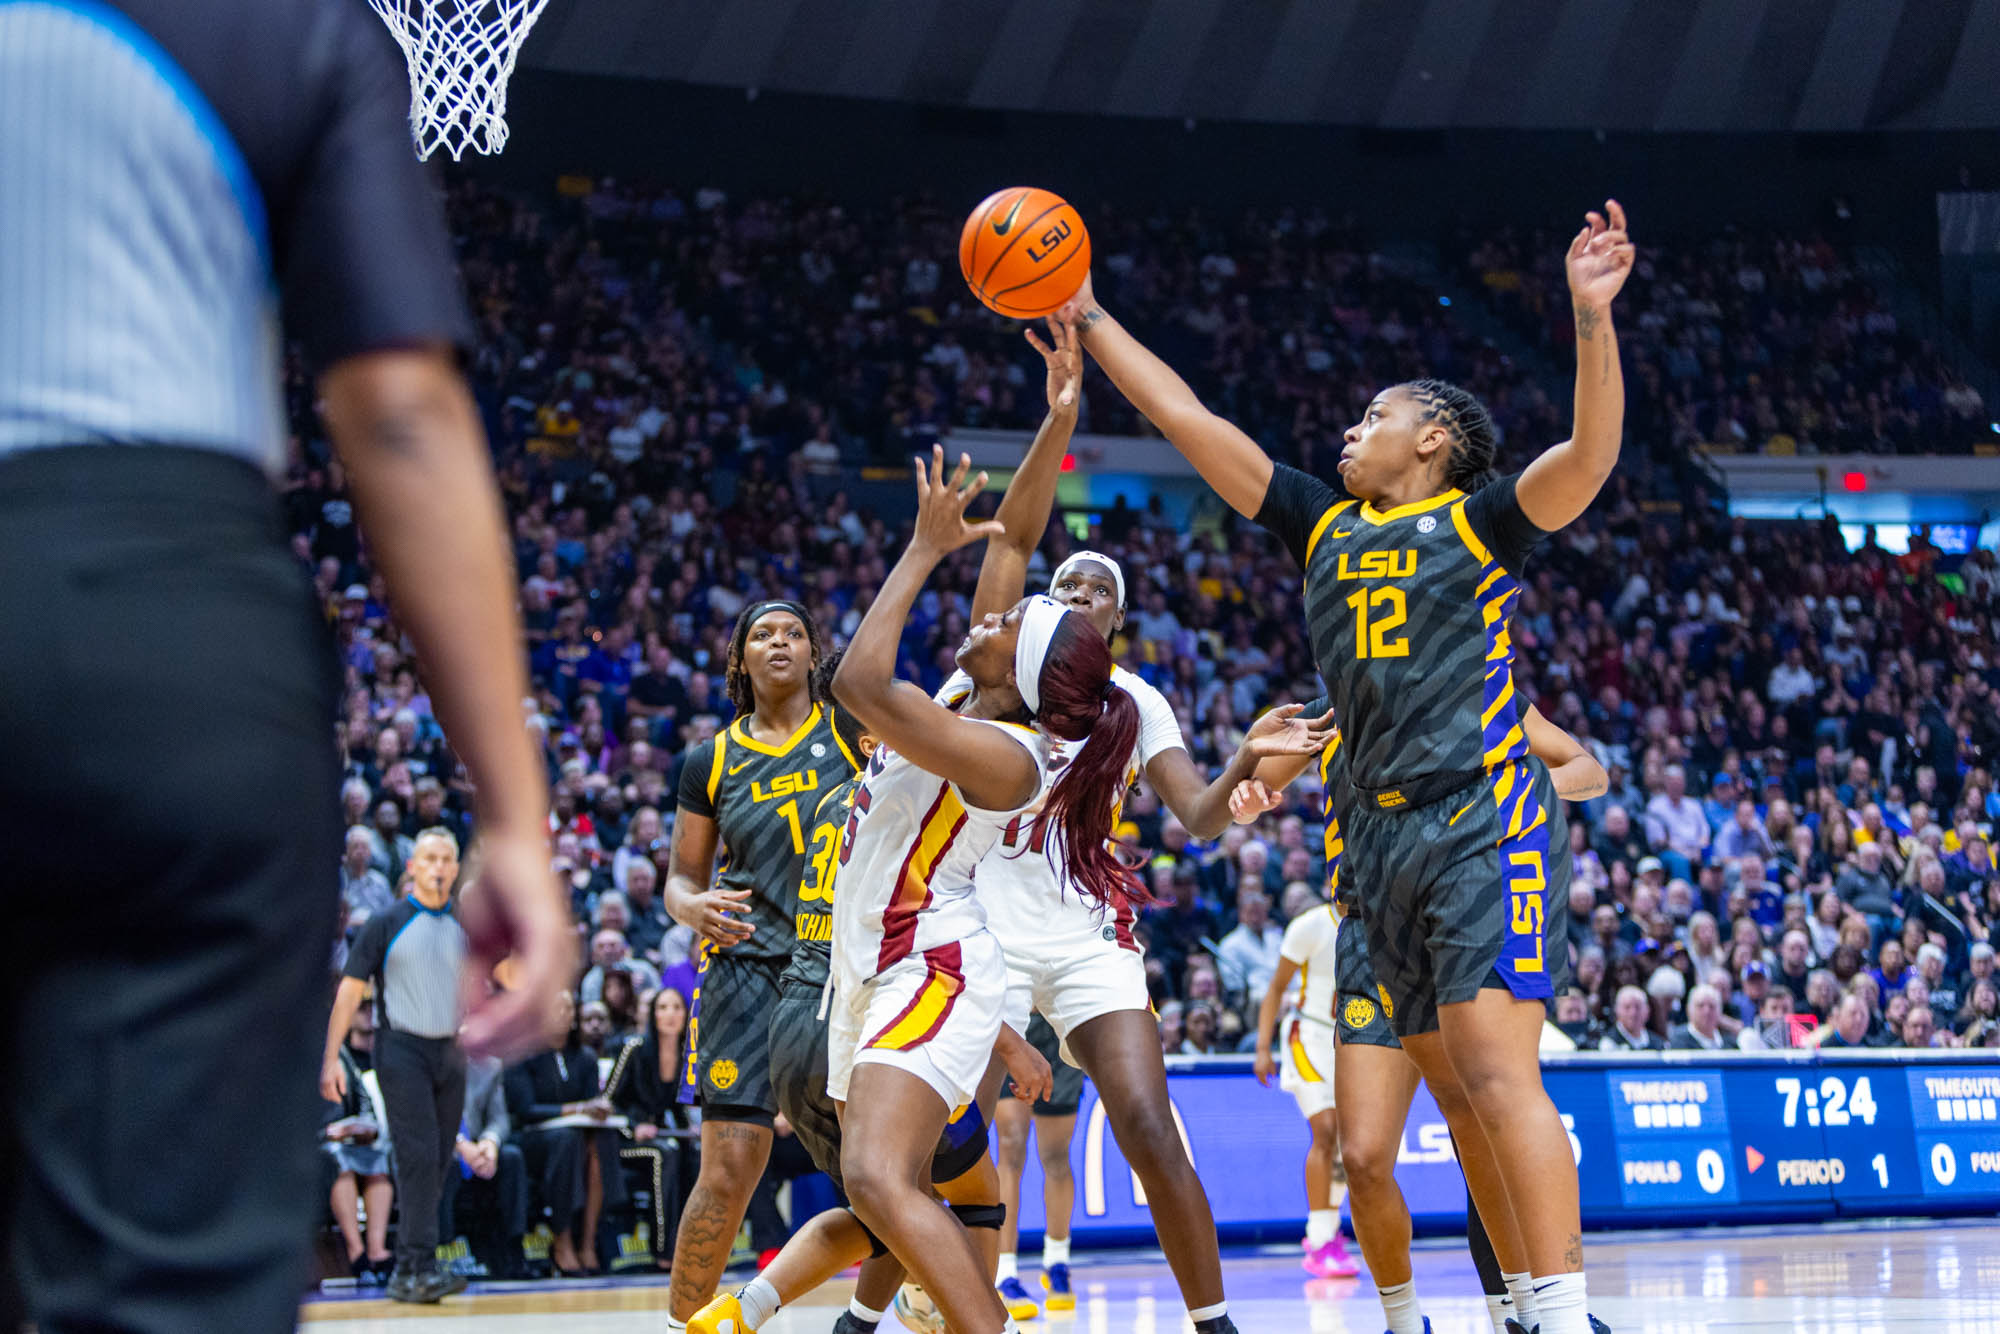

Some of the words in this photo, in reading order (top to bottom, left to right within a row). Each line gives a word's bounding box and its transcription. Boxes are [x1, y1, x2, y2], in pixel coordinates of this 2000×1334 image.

[1026, 219, 1072, 264] LSU
[1337, 549, 1417, 581] LSU
[1346, 585, 1410, 659] 12
[751, 769, 818, 803] LSU
[776, 799, 805, 855] 1
[1508, 850, 1546, 972] LSU
[1620, 1080, 1708, 1104] TIMEOUTS
[1776, 1076, 1877, 1127] 7:24
[1925, 1077, 2000, 1099] TIMEOUTS
[1396, 1122, 1459, 1165] LS
[1931, 1143, 1957, 1186] 0
[1624, 1160, 1682, 1184] FOULS
[1697, 1149, 1725, 1194] 0
[1777, 1158, 1846, 1187] PERIOD
[1872, 1153, 1889, 1189] 1
